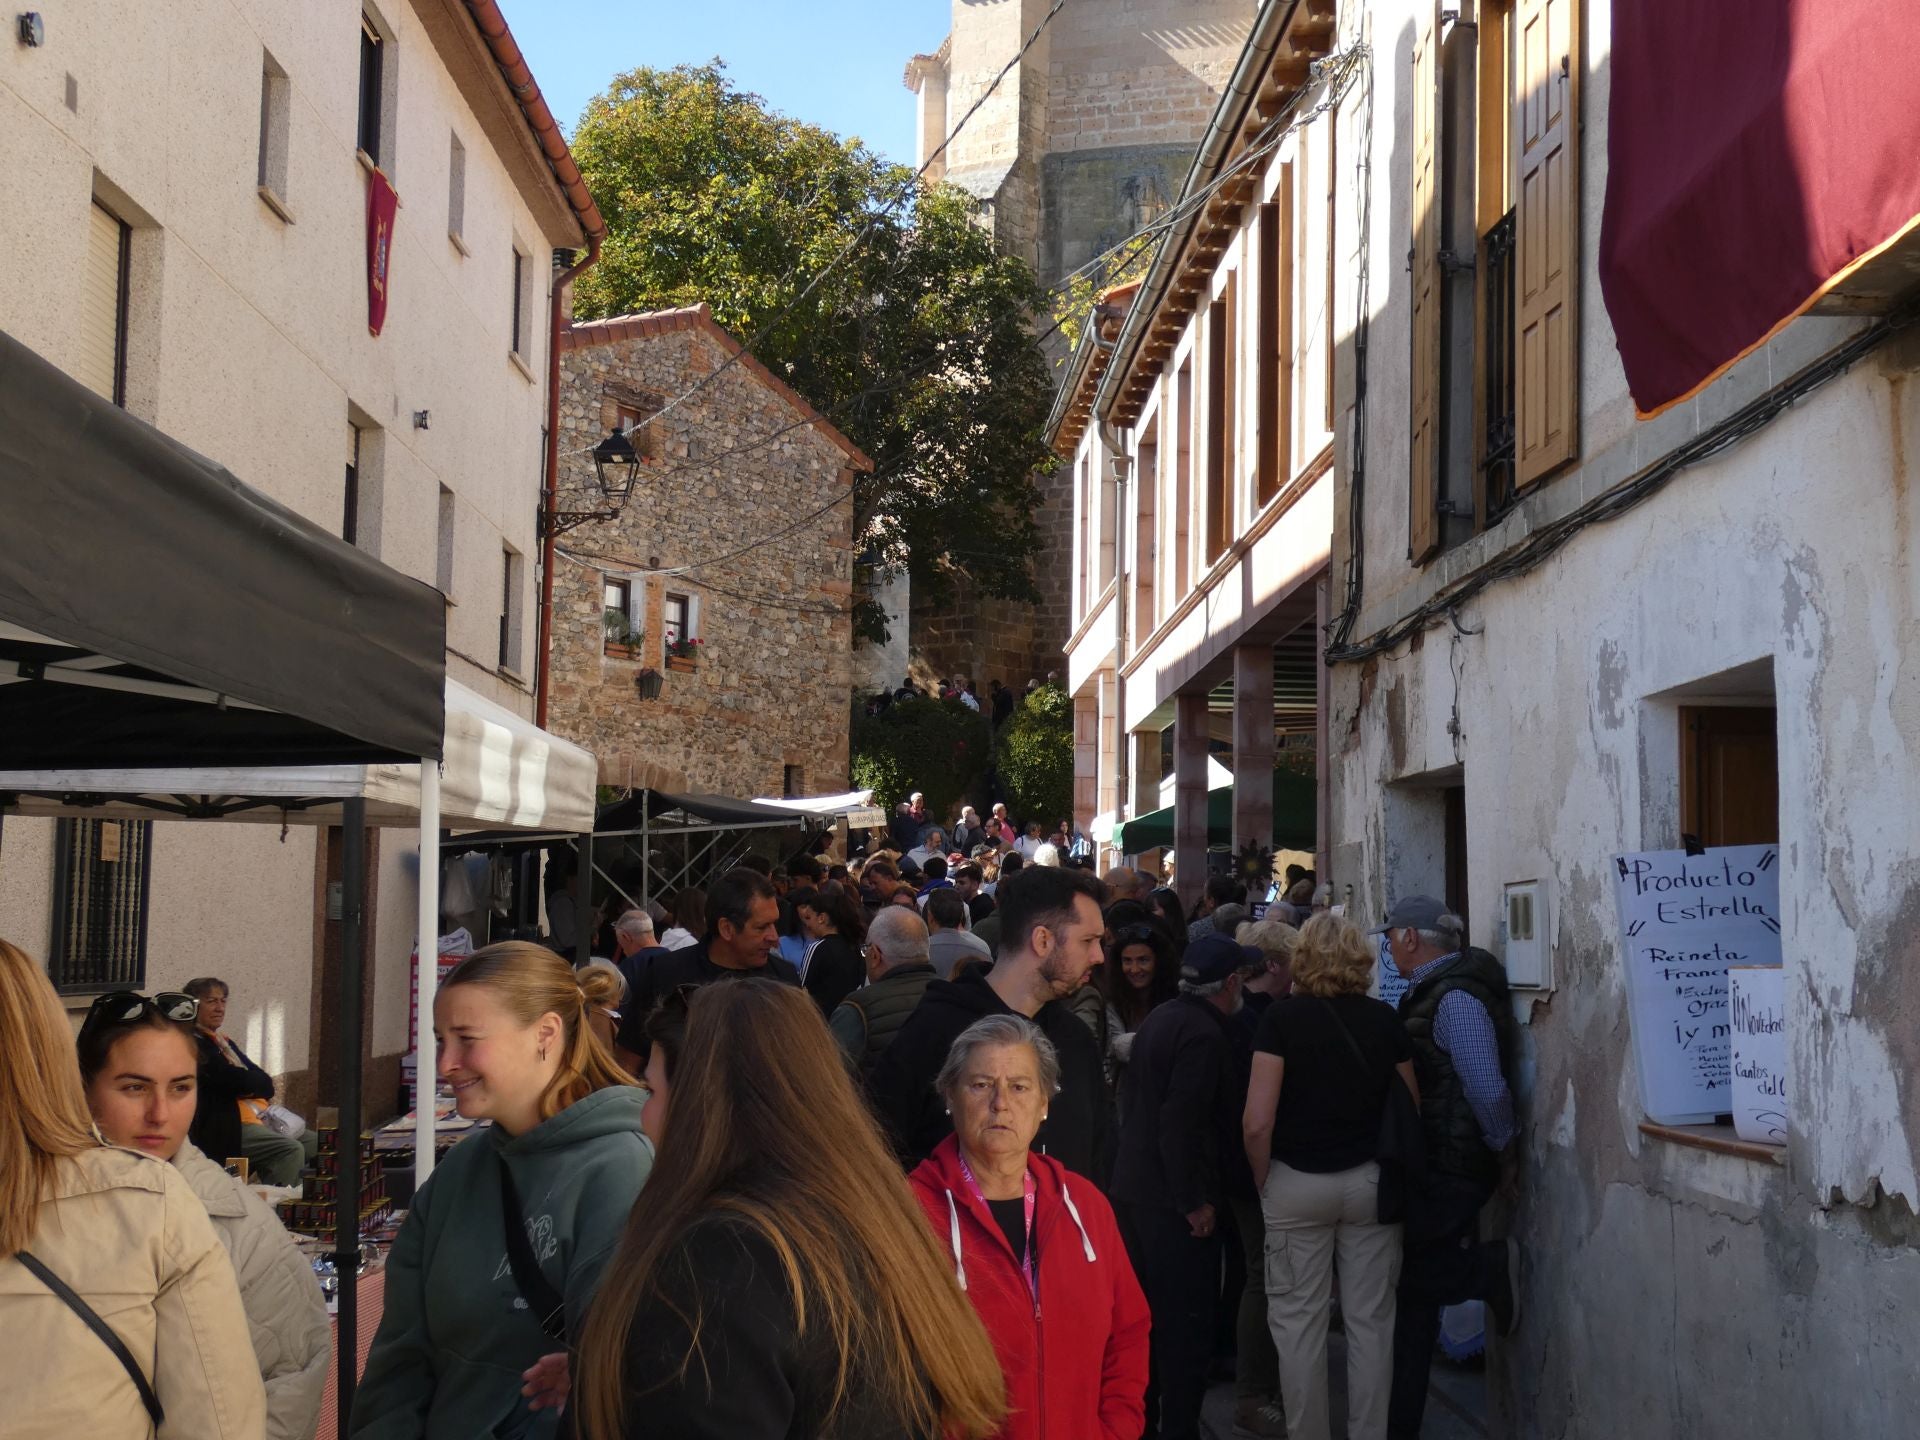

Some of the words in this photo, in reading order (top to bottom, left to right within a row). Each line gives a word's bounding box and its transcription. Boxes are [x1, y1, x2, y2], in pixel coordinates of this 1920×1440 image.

[1628, 856, 1756, 896] Producto
[1656, 895, 1770, 924] Estrella
[1642, 943, 1749, 963] Reineta
[1735, 1059, 1769, 1080] Cantos
[1757, 1074, 1776, 1096] del
